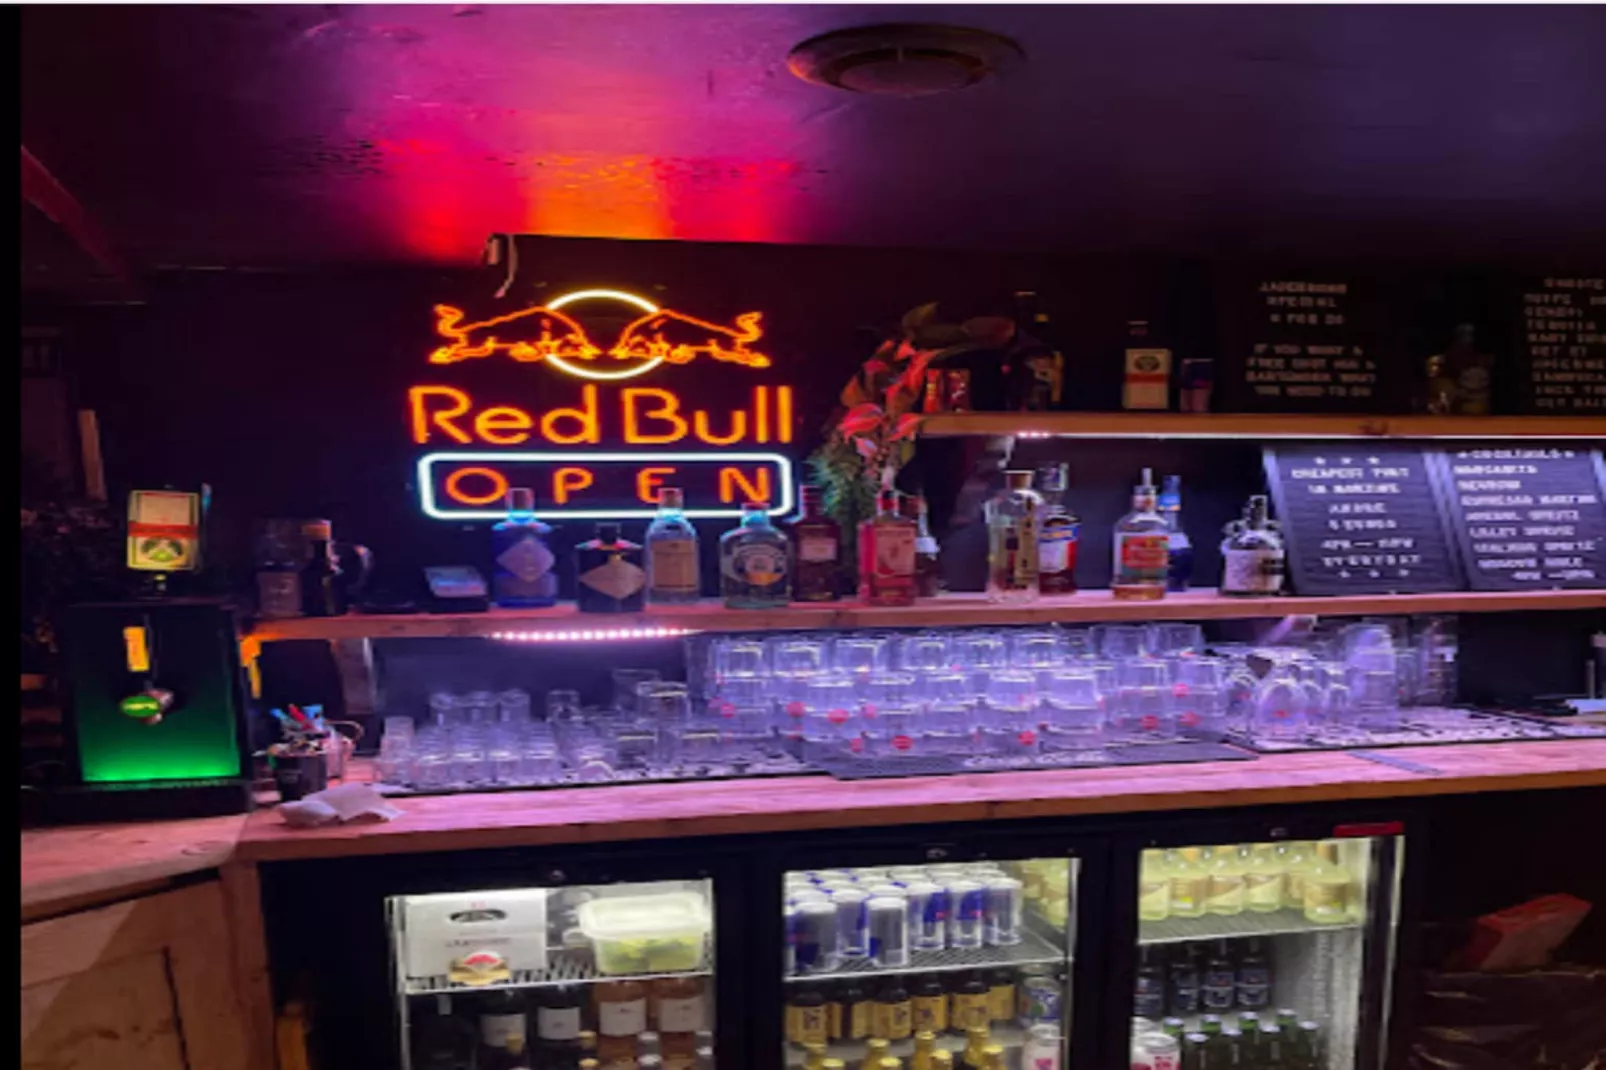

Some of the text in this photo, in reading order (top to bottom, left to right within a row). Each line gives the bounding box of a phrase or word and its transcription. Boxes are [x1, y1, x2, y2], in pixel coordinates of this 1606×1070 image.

[408, 384, 792, 445] Red Bull
[445, 466, 771, 505] OPEN
